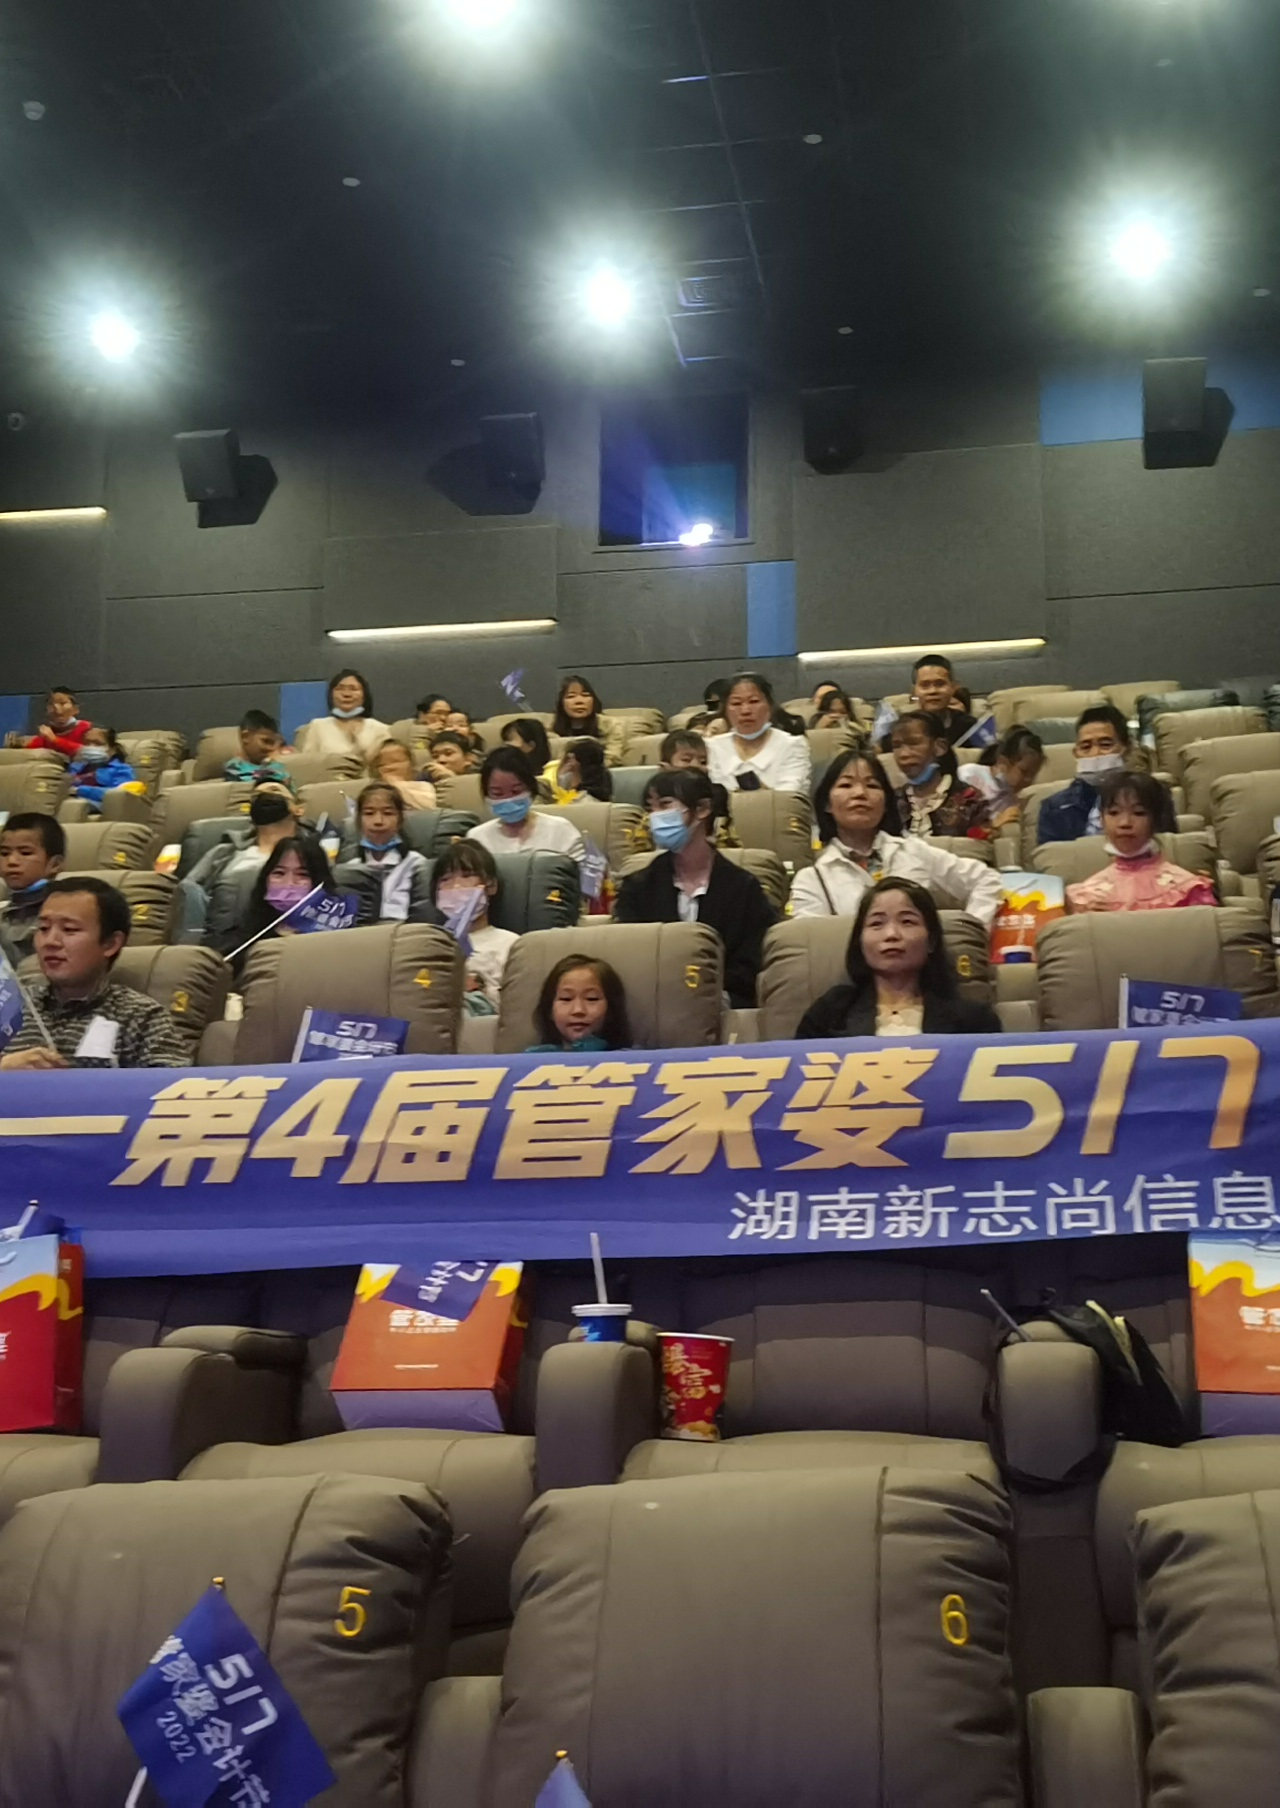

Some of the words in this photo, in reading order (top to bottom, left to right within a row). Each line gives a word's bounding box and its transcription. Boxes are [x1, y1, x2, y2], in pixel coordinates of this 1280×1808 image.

[684, 964, 701, 989] 5
[333, 1586, 370, 1637] 5
[939, 1594, 968, 1645] 6
[204, 1652, 279, 1736] 517
[156, 1710, 196, 1763] 2022
